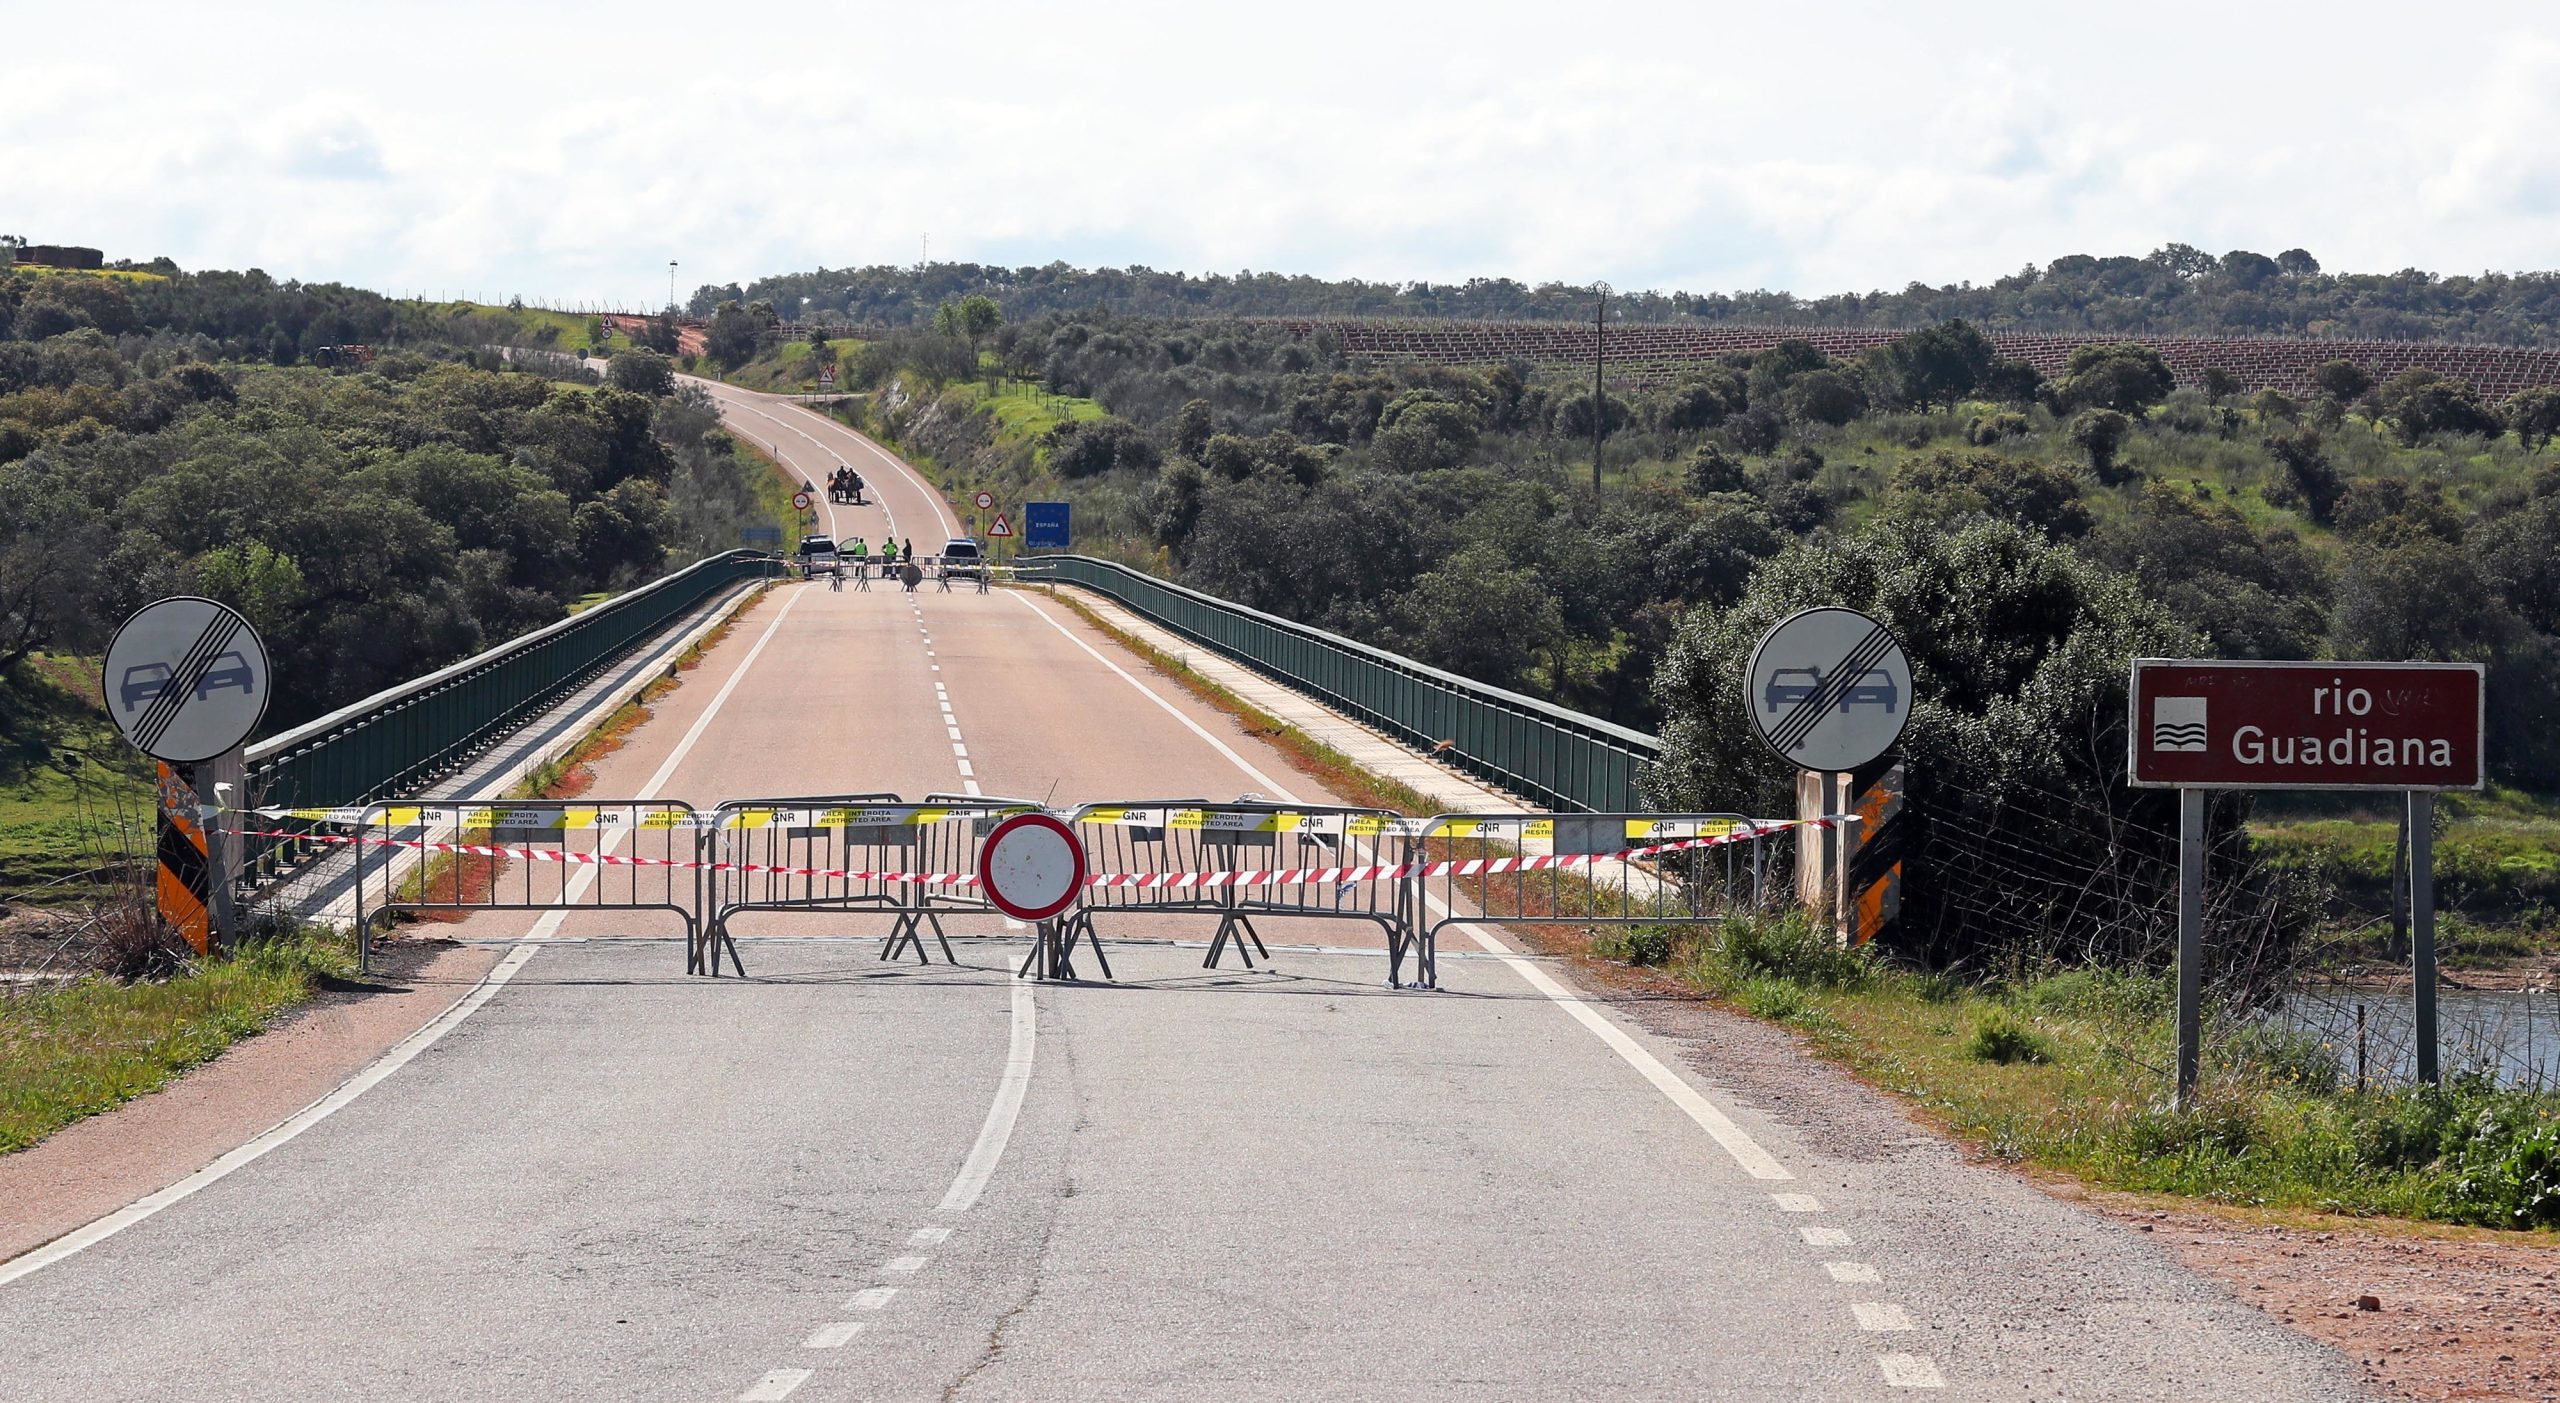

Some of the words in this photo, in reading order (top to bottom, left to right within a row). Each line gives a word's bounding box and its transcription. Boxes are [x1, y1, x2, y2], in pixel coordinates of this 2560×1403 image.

[2314, 678, 2373, 716] rio
[2232, 725, 2453, 767] Guadiana
[290, 812, 339, 820] RESTRICTED
[418, 811, 442, 821] GNR
[595, 814, 618, 823] GNR
[771, 812, 795, 822] GNR
[1122, 811, 1147, 821] GNR
[1300, 817, 1324, 828] GNR
[1476, 822, 1500, 832] GNR
[1652, 822, 1675, 832] GNR
